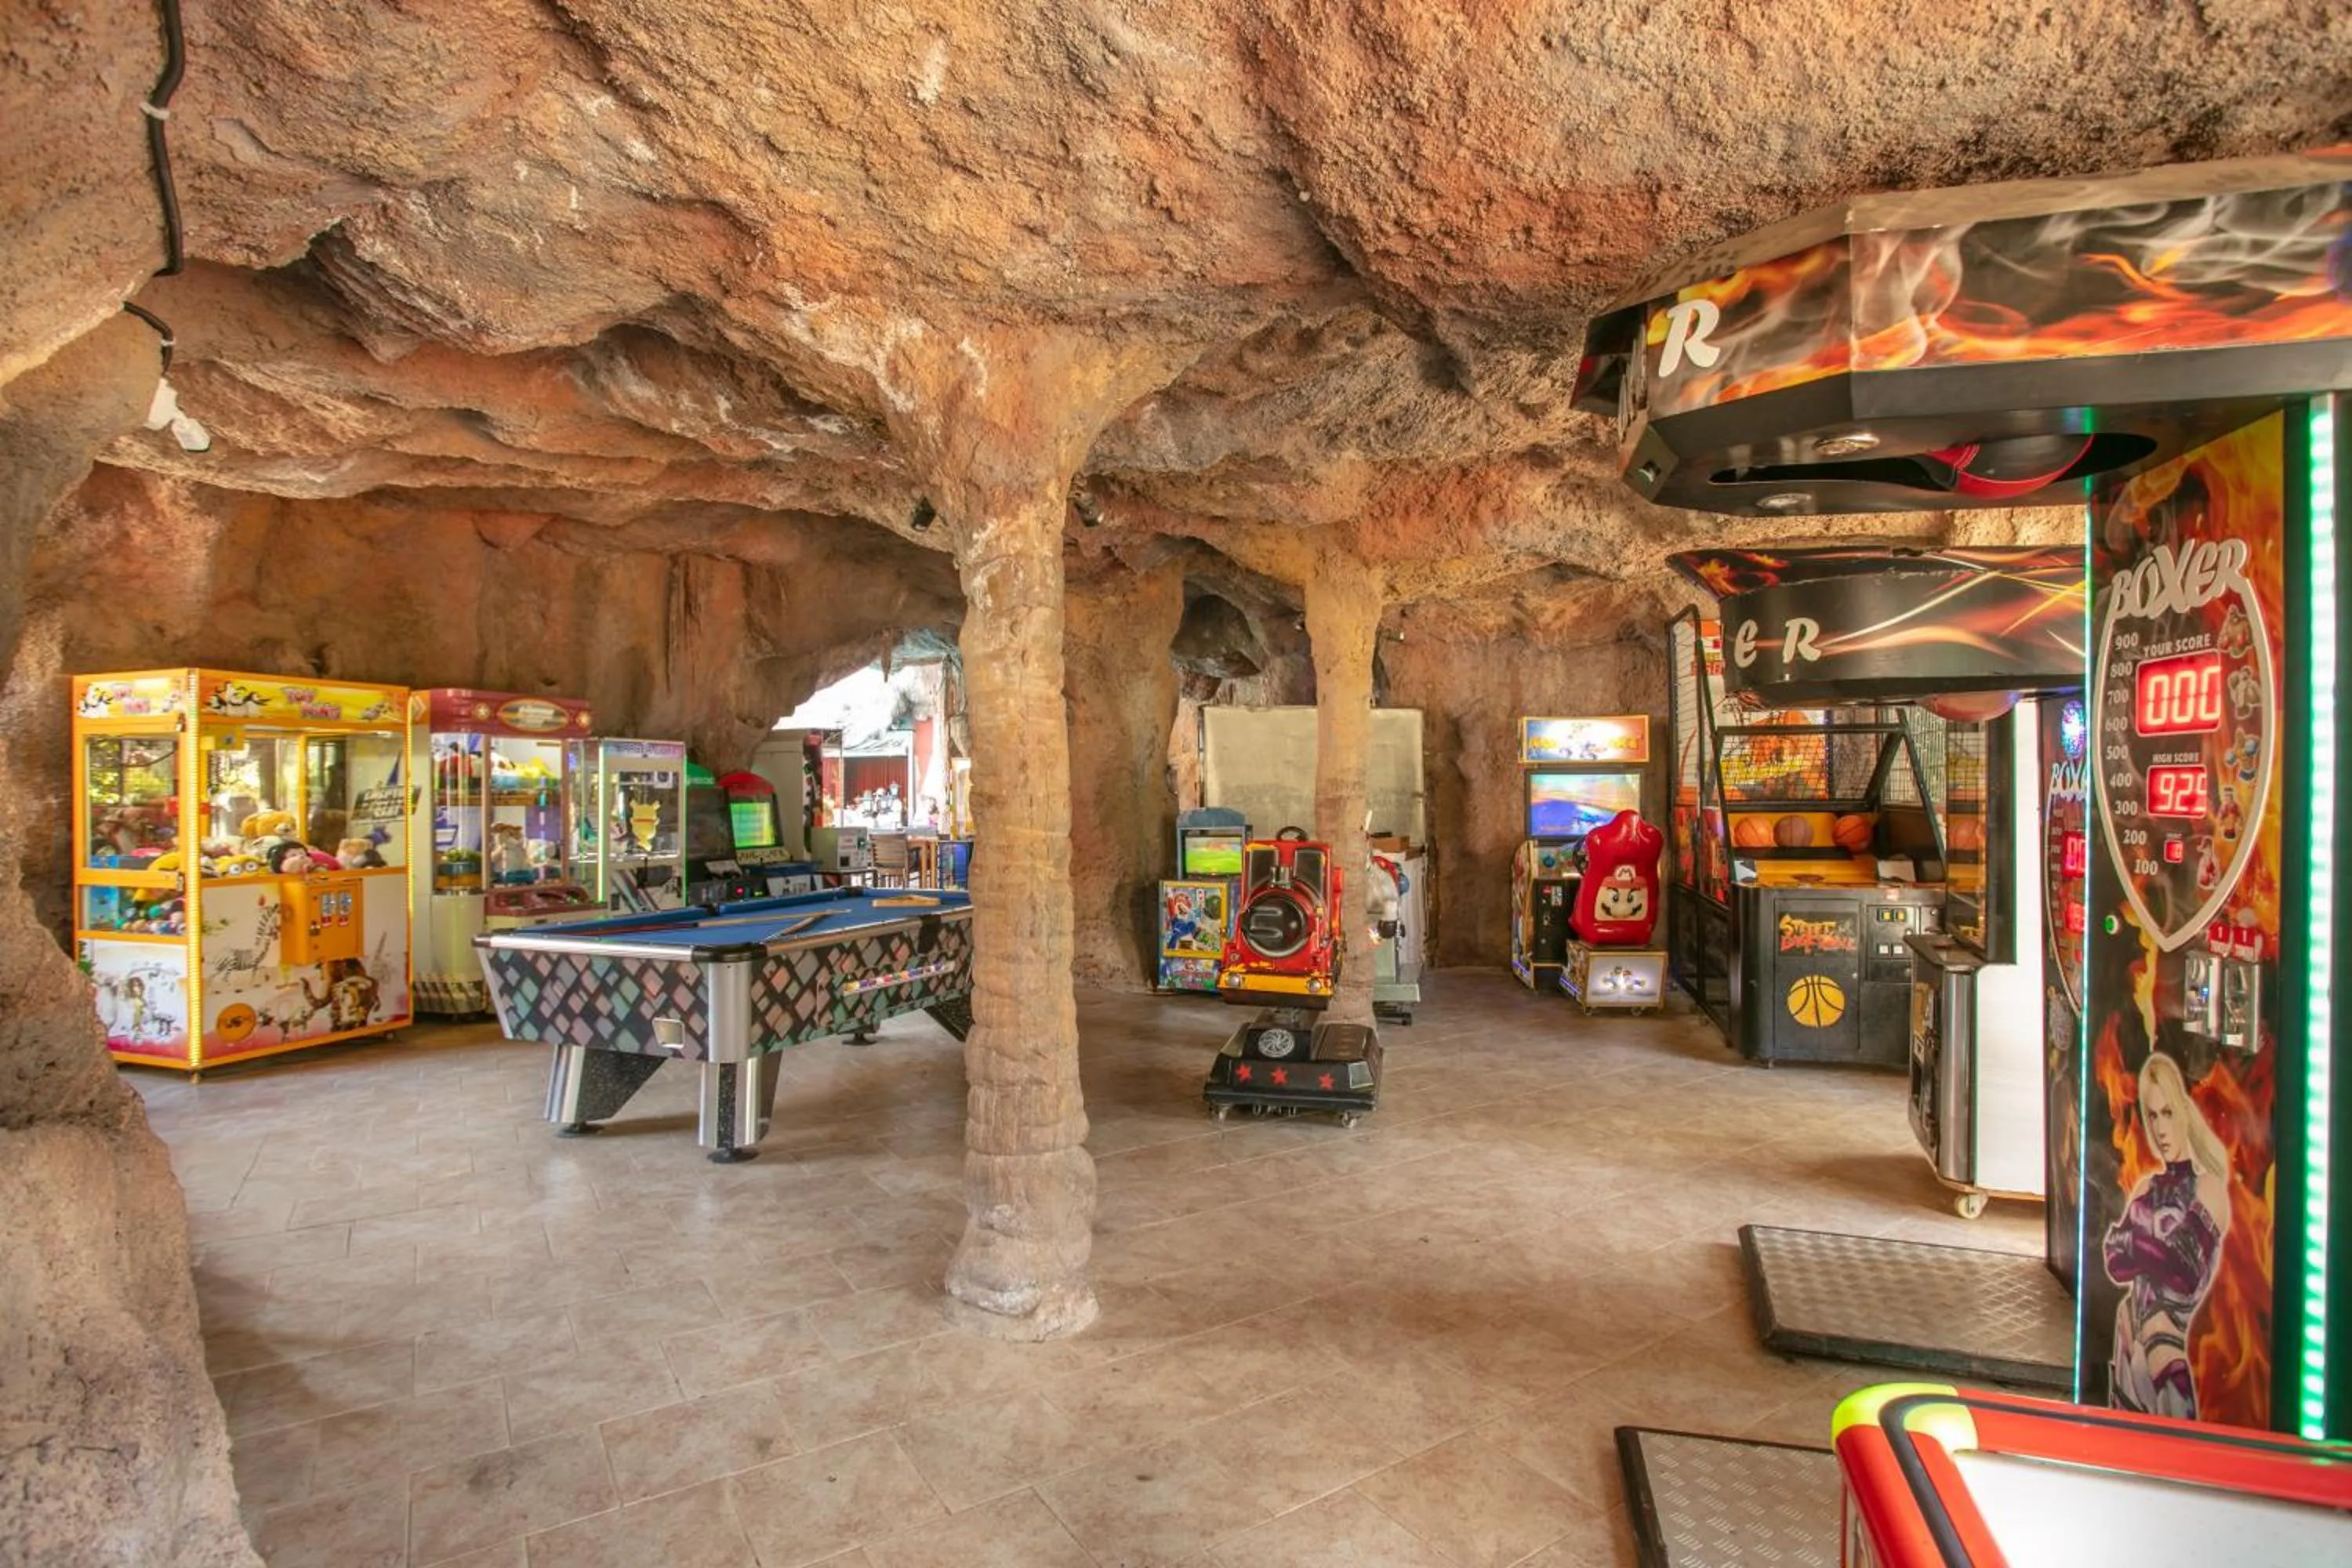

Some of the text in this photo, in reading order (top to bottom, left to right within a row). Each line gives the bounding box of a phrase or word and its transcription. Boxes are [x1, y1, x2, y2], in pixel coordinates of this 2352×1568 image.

[2111, 539, 2248, 619] BOXER
[2115, 633, 2139, 650] 900
[2143, 633, 2211, 657] YOUR SCORE
[2111, 662, 2133, 678] 800
[2107, 689, 2129, 705] 700
[2106, 717, 2128, 731] 600
[2106, 746, 2129, 760] 500
[2152, 752, 2199, 764] HIGH SCORE
[2110, 772, 2132, 788] 400
[2114, 800, 2138, 815] 300
[2123, 829, 2147, 845] 200
[2134, 859, 2158, 877] 100
